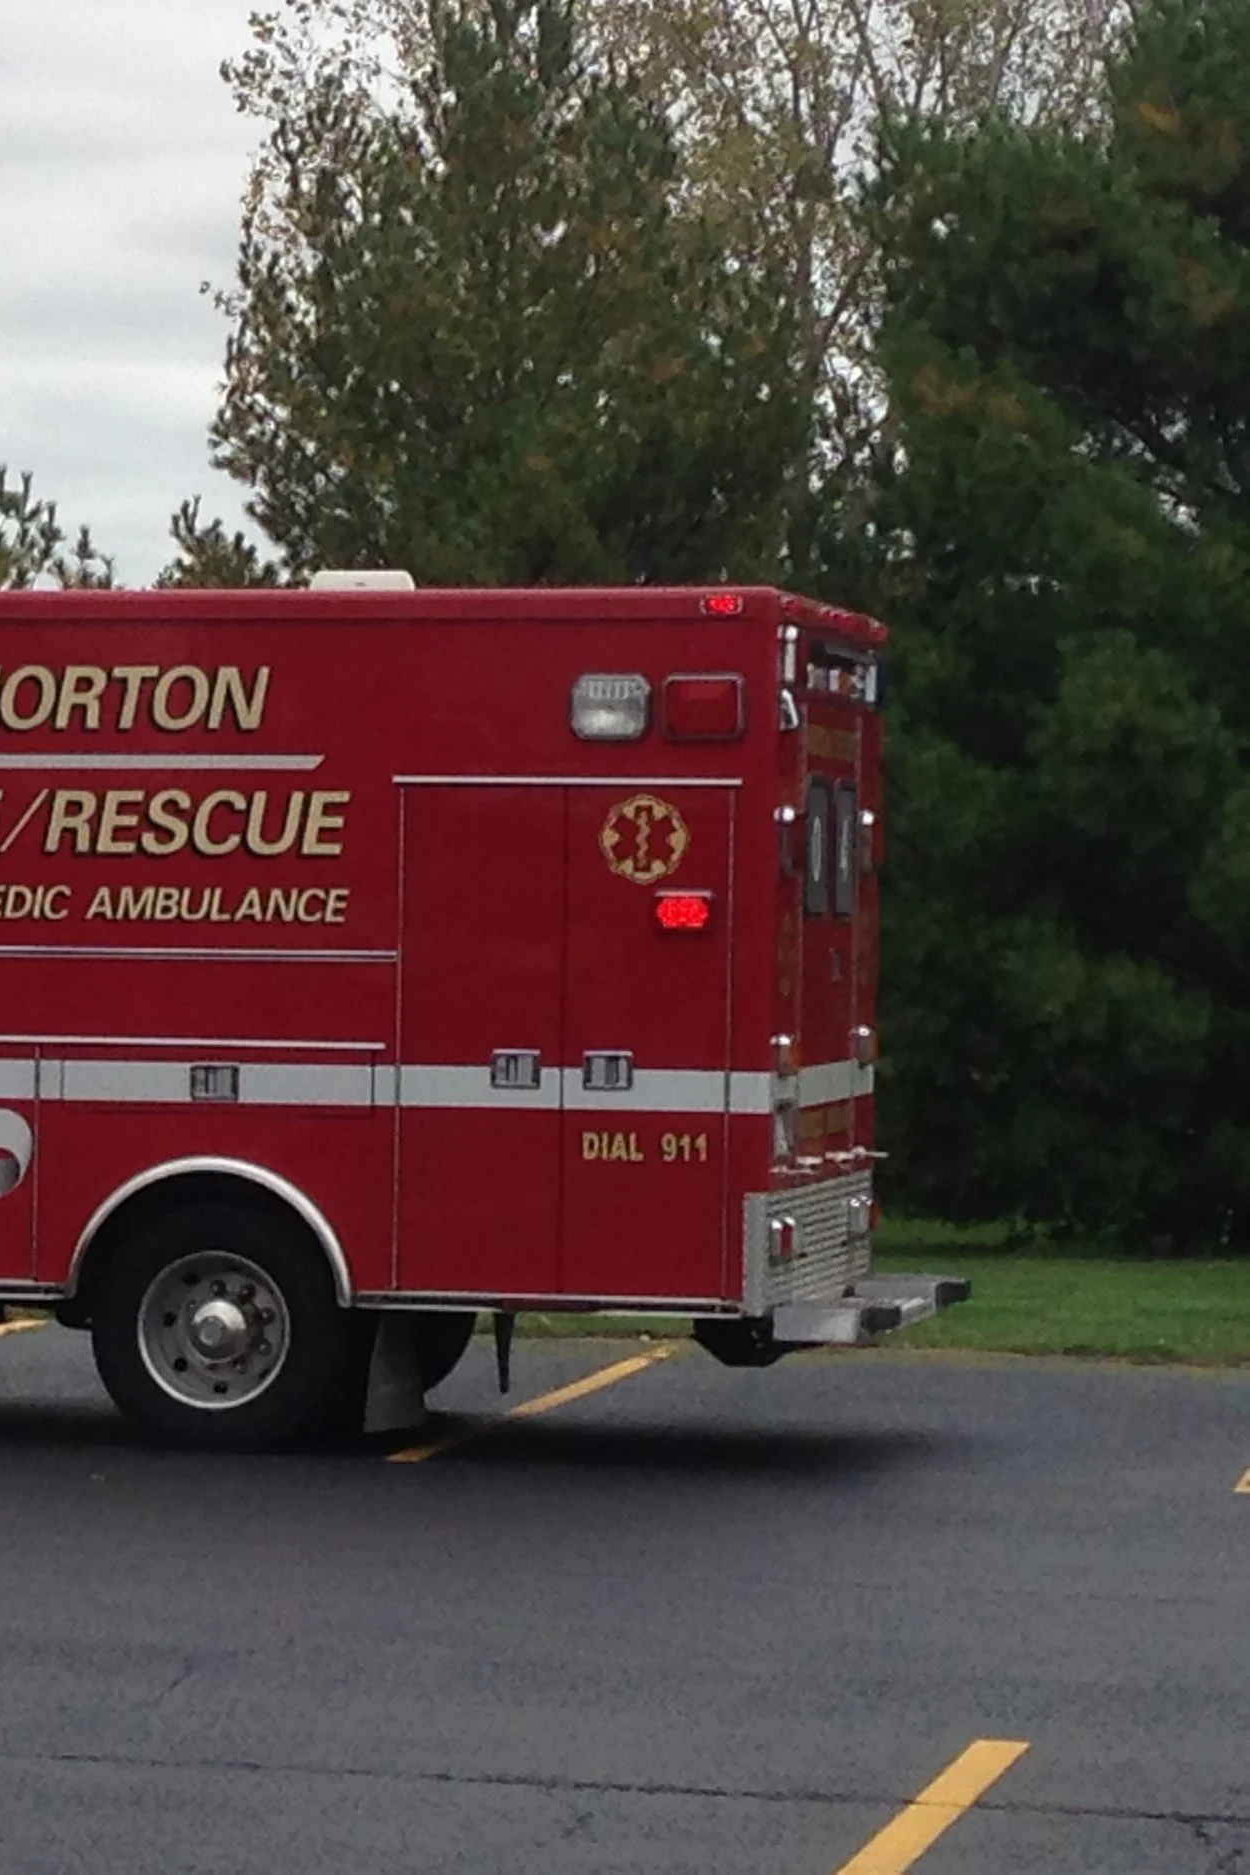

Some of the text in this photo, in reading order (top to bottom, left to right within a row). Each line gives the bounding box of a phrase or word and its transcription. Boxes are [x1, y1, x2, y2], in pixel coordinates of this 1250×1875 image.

[84, 887, 349, 923] AMBULANCE
[581, 1132, 708, 1162] DIAL 911
